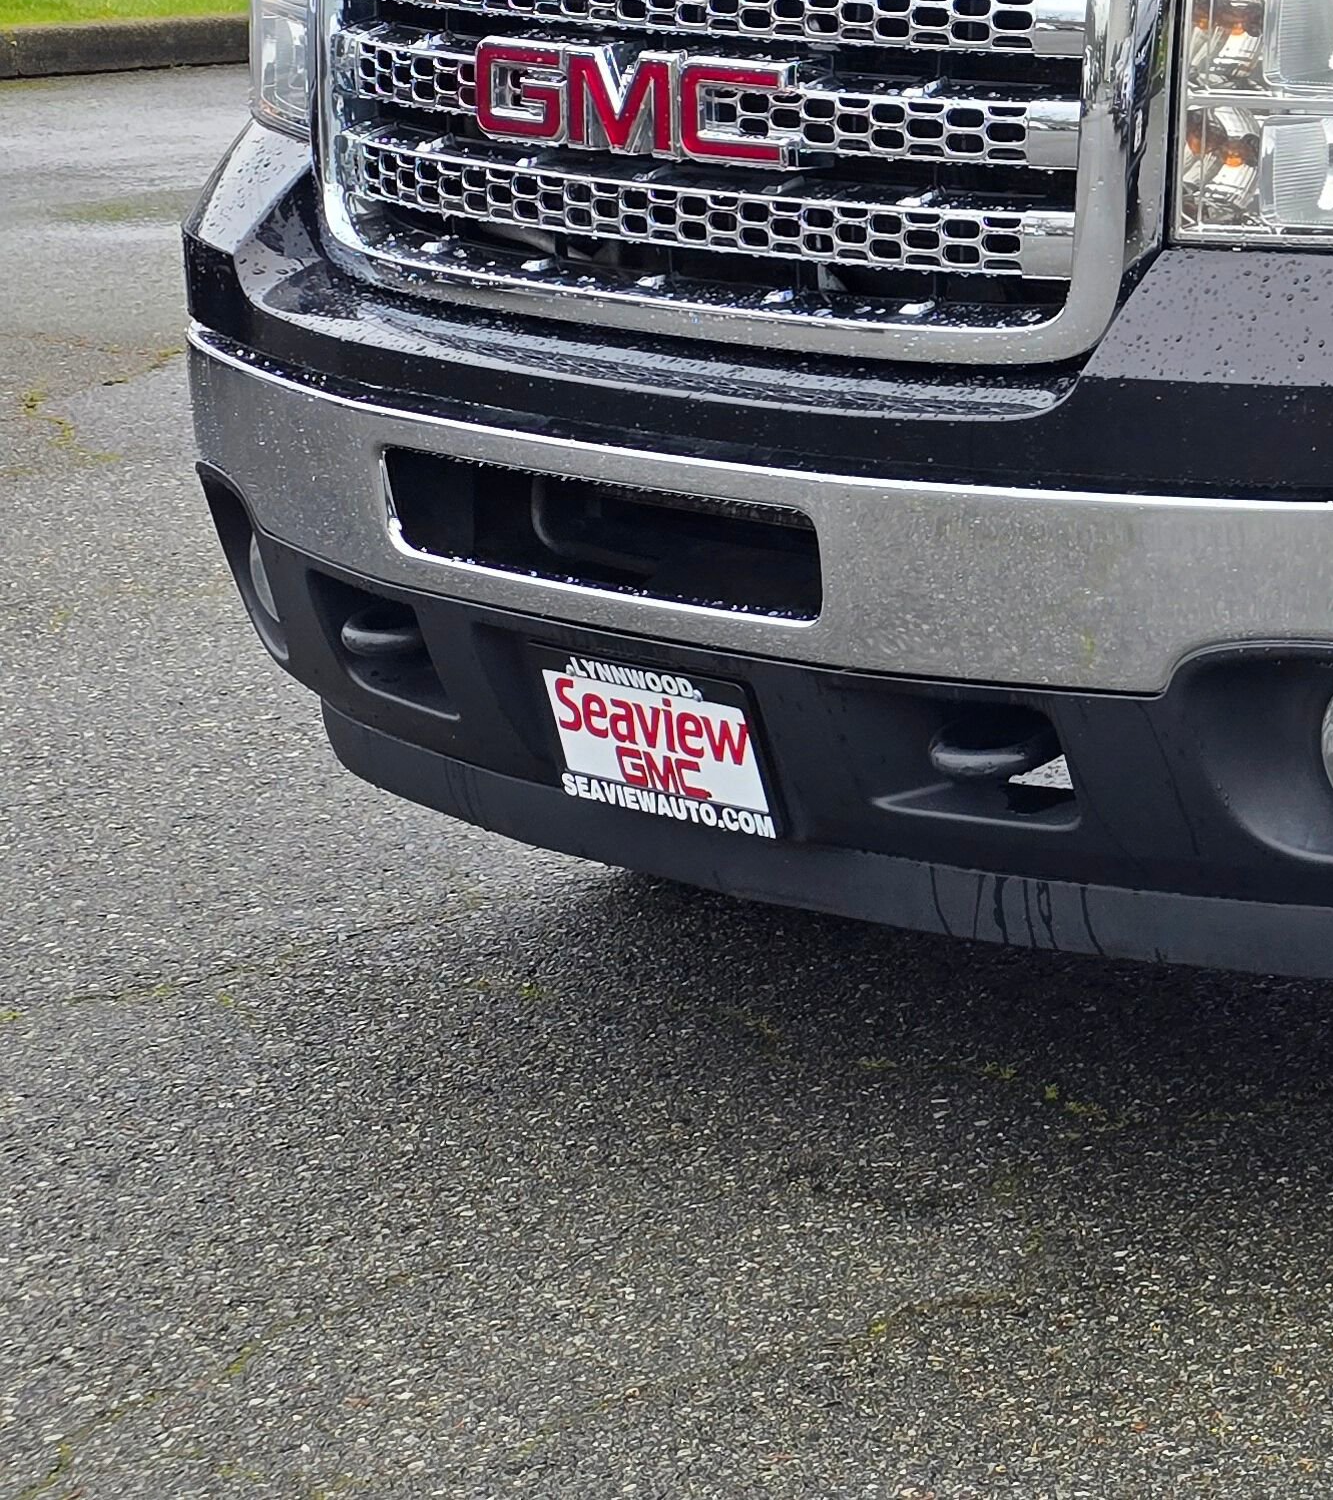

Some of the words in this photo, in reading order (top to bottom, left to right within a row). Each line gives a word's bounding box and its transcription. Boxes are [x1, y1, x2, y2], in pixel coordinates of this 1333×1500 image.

[475, 35, 799, 170] GMC
[569, 656, 694, 698] LYNNWOOD
[554, 677, 750, 766] Seaview
[561, 773, 777, 840] SEAVIEWAUTO.COM
[615, 745, 712, 801] GMC
